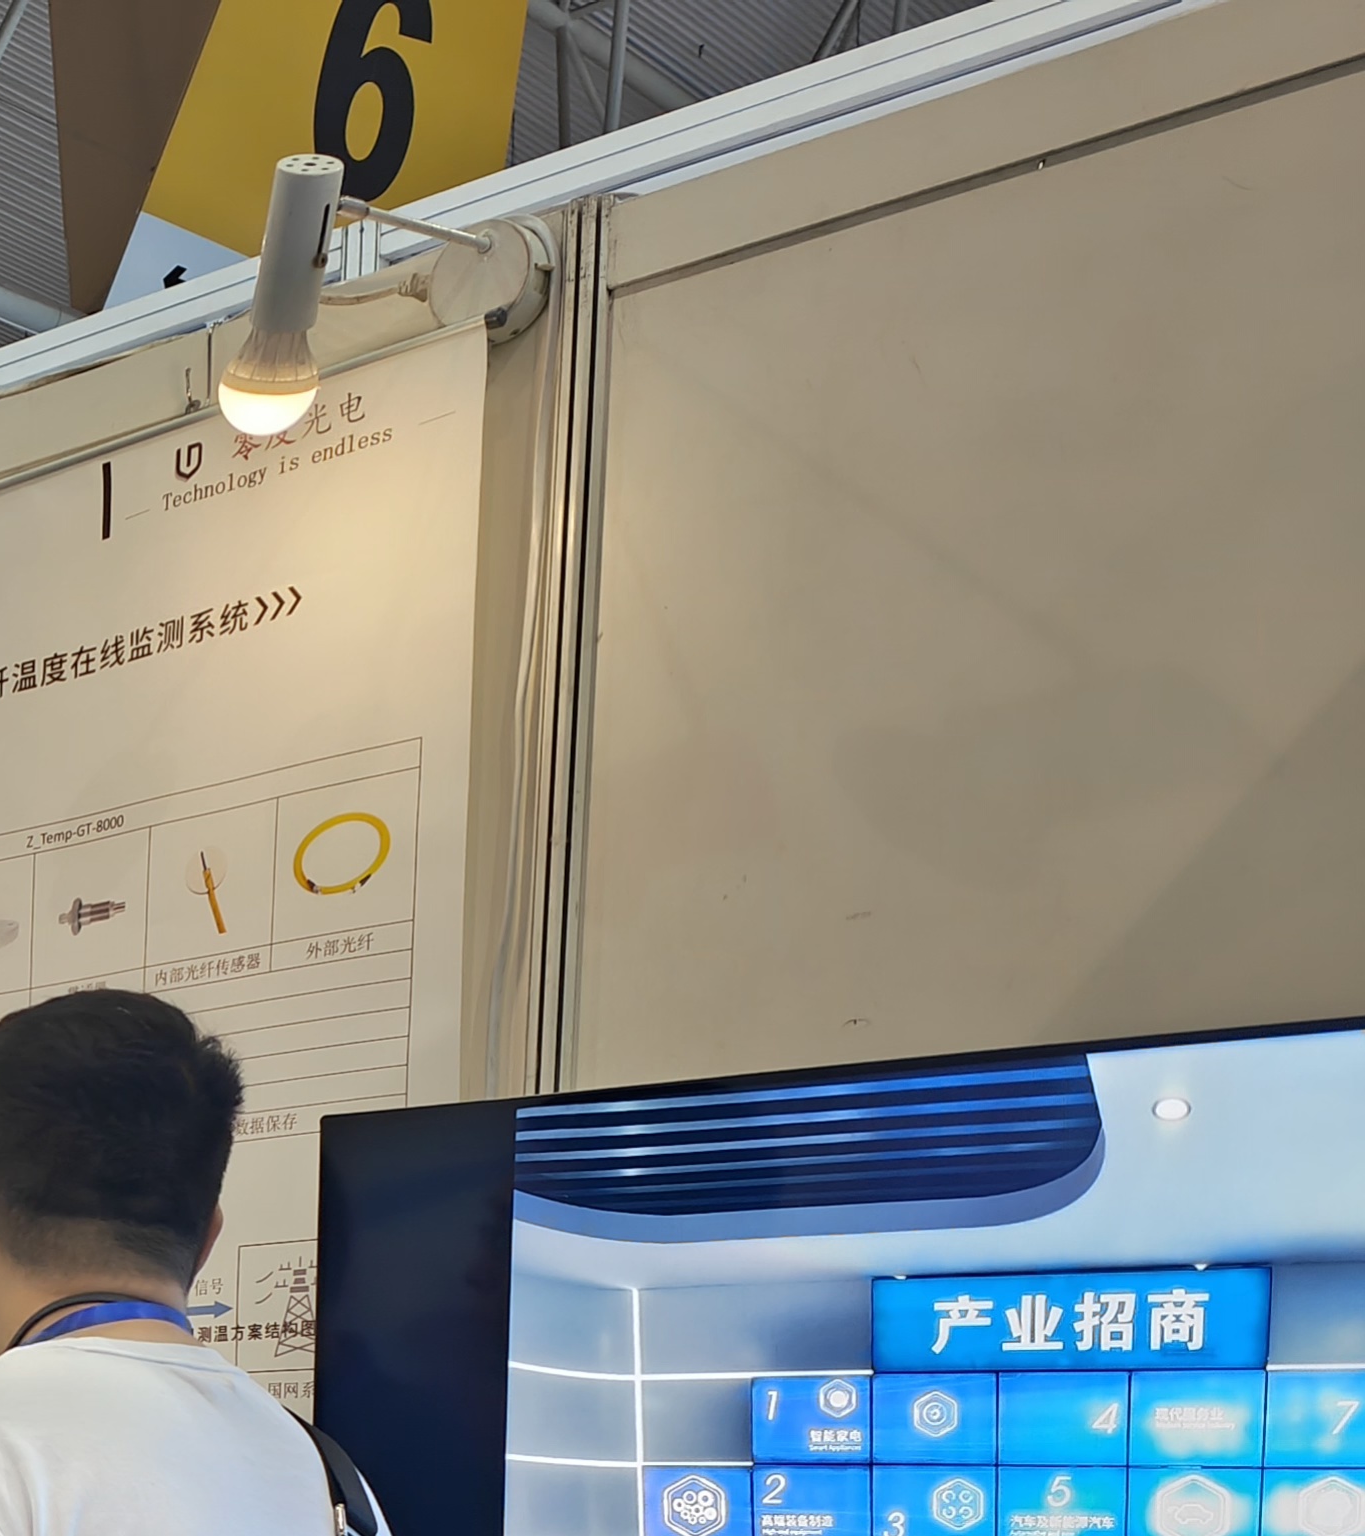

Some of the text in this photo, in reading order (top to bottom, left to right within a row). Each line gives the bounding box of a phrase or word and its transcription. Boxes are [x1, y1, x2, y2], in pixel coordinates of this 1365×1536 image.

[313, 0, 433, 202] 6
[161, 424, 394, 513] Technology is endless
[25, 814, 126, 851] Z_Temp-GT-8000
[305, 930, 375, 961] 外部光纤
[153, 951, 262, 987] 内部光纤传感器
[194, 1277, 224, 1297] 信号
[930, 1287, 1211, 1356] 产业招商
[767, 1390, 779, 1422] 1
[1091, 1402, 1120, 1435] 4
[1332, 1400, 1360, 1436] 7
[761, 1473, 787, 1505] 2
[1047, 1475, 1072, 1508] 5
